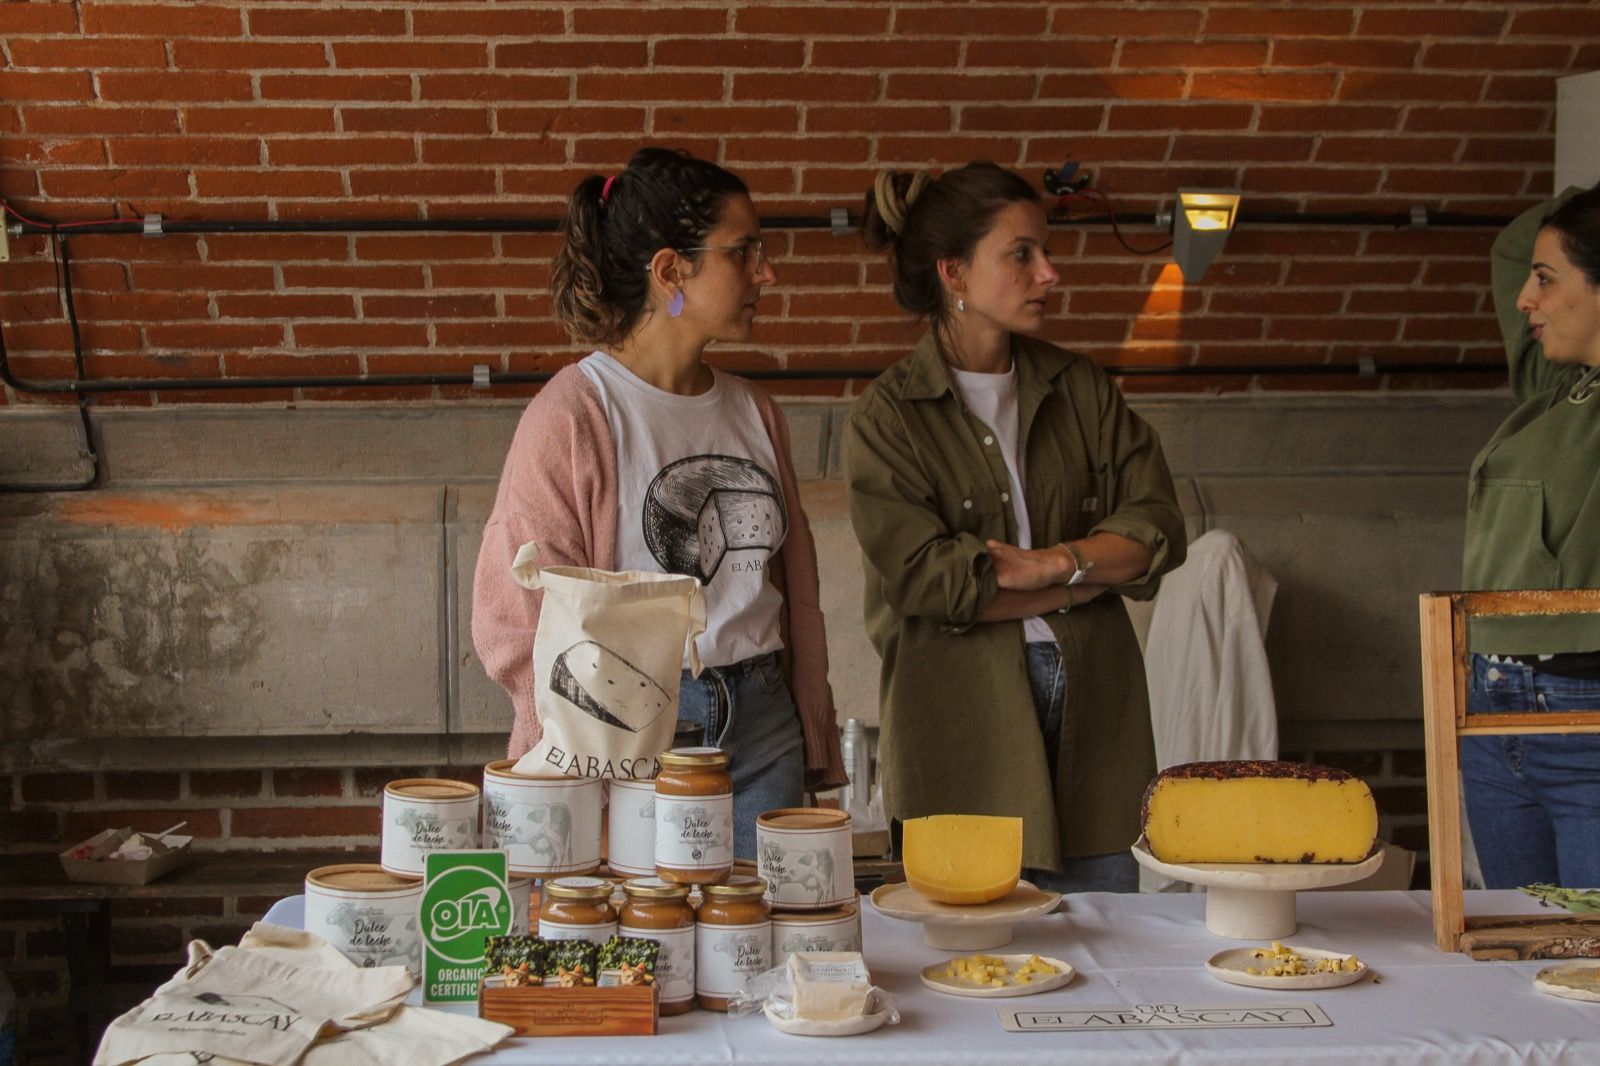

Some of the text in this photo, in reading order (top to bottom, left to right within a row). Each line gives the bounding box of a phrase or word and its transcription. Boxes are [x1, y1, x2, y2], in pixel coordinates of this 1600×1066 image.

[732, 563, 743, 572] EL
[415, 821, 441, 834] Dulce
[493, 816, 513, 832] leche
[684, 816, 710, 829] Dulce
[423, 834, 445, 842] leche
[681, 829, 713, 839] de leche
[769, 863, 787, 873] leche
[431, 898, 501, 931] OIA
[354, 919, 386, 935] Dulce
[349, 934, 393, 947] de leche
[737, 944, 760, 958] Dulce
[734, 958, 744, 966] de
[431, 982, 480, 996] CERTIFIC
[1032, 1011, 1289, 1025] EL ABASCAY
